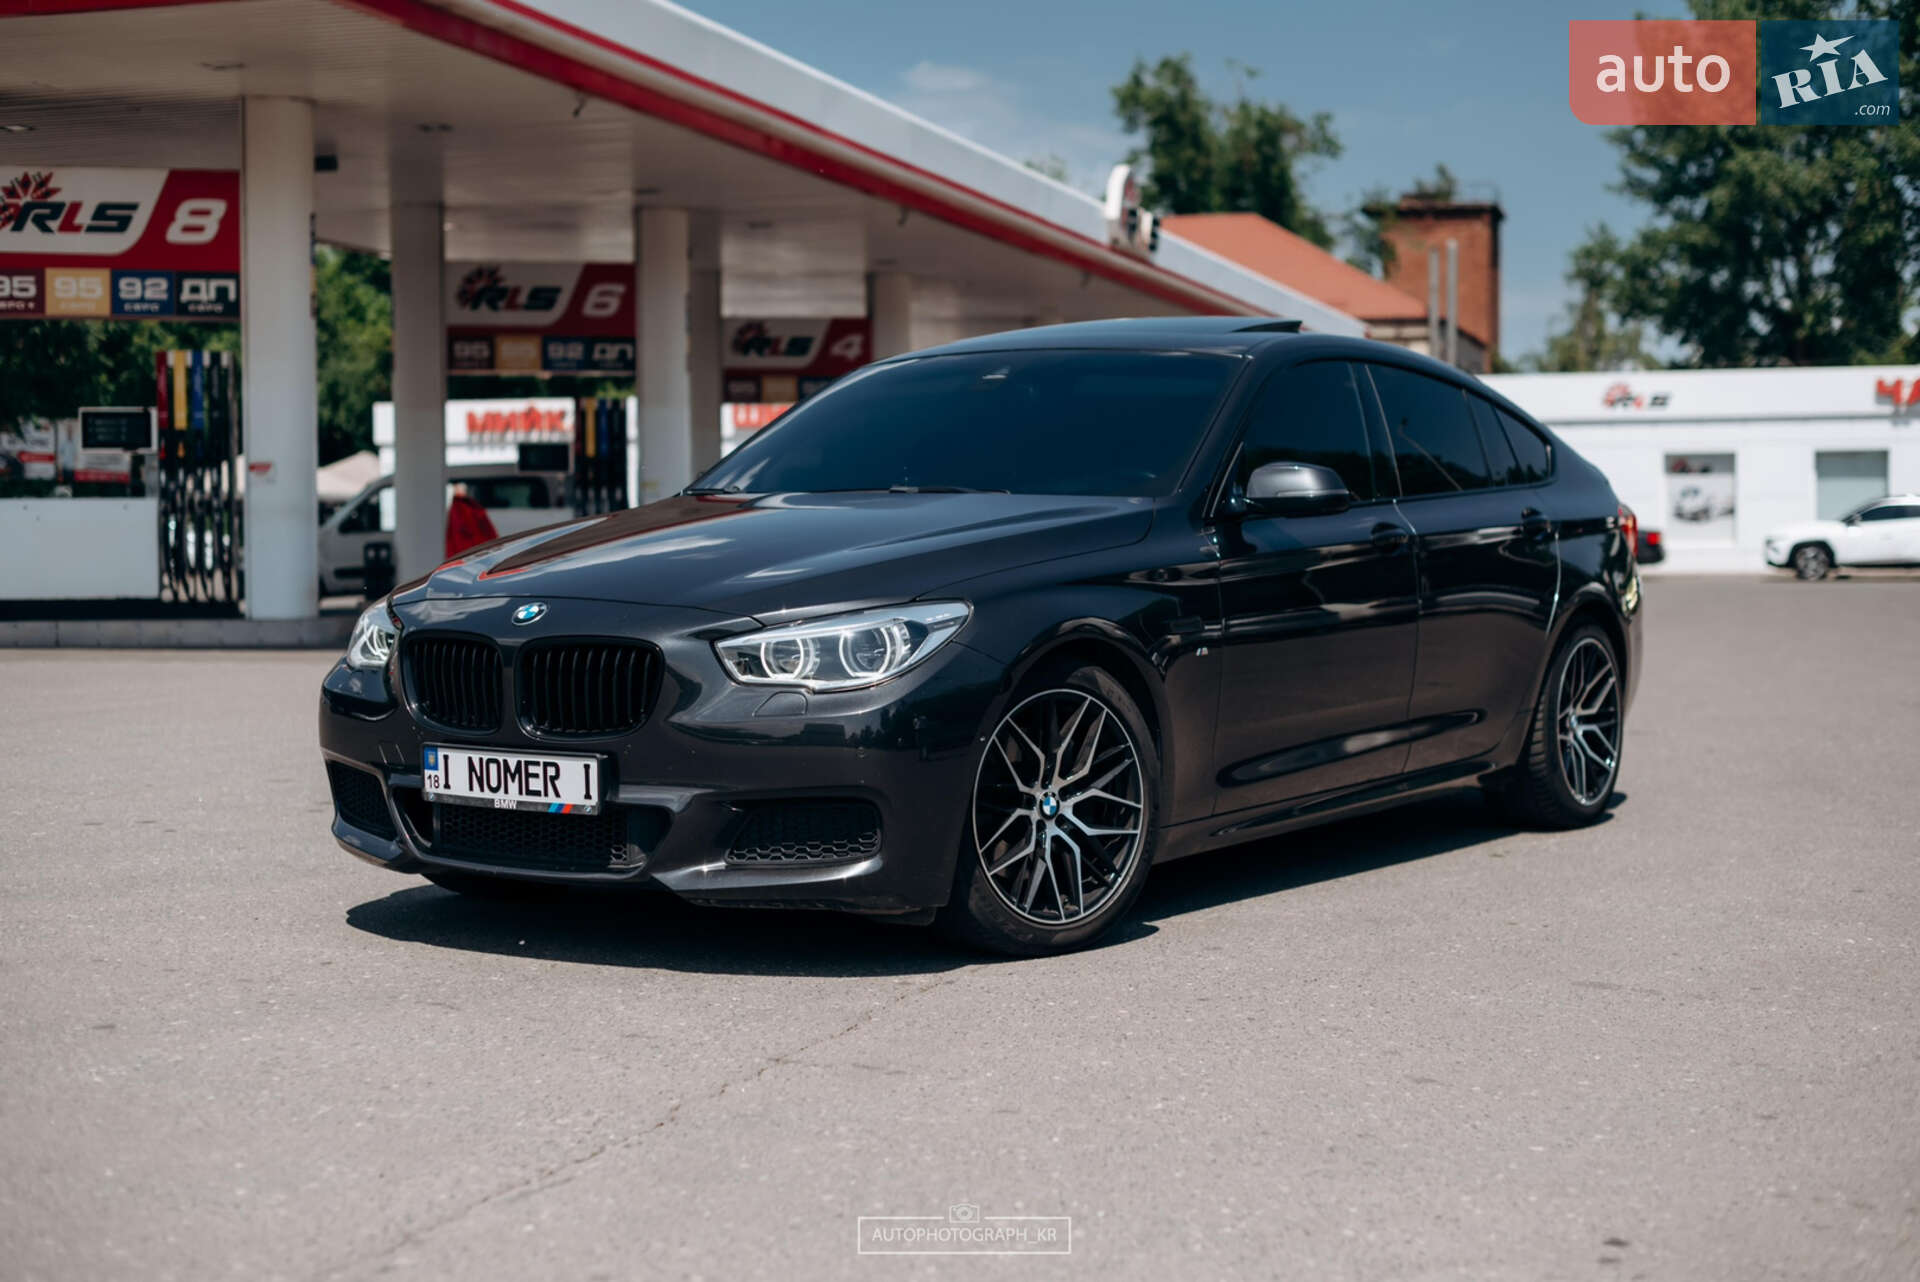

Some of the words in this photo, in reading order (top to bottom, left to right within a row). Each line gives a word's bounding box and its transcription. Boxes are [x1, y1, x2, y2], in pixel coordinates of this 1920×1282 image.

[10, 201, 140, 233] RLS
[165, 197, 228, 245] 8
[54, 276, 103, 299] 95
[118, 276, 169, 300] 92
[582, 284, 626, 318] 6
[828, 333, 864, 359] 4
[466, 402, 575, 433] МИЙК
[427, 773, 440, 789] 18
[467, 756, 561, 798] NOMER
[494, 799, 518, 810] BMW
